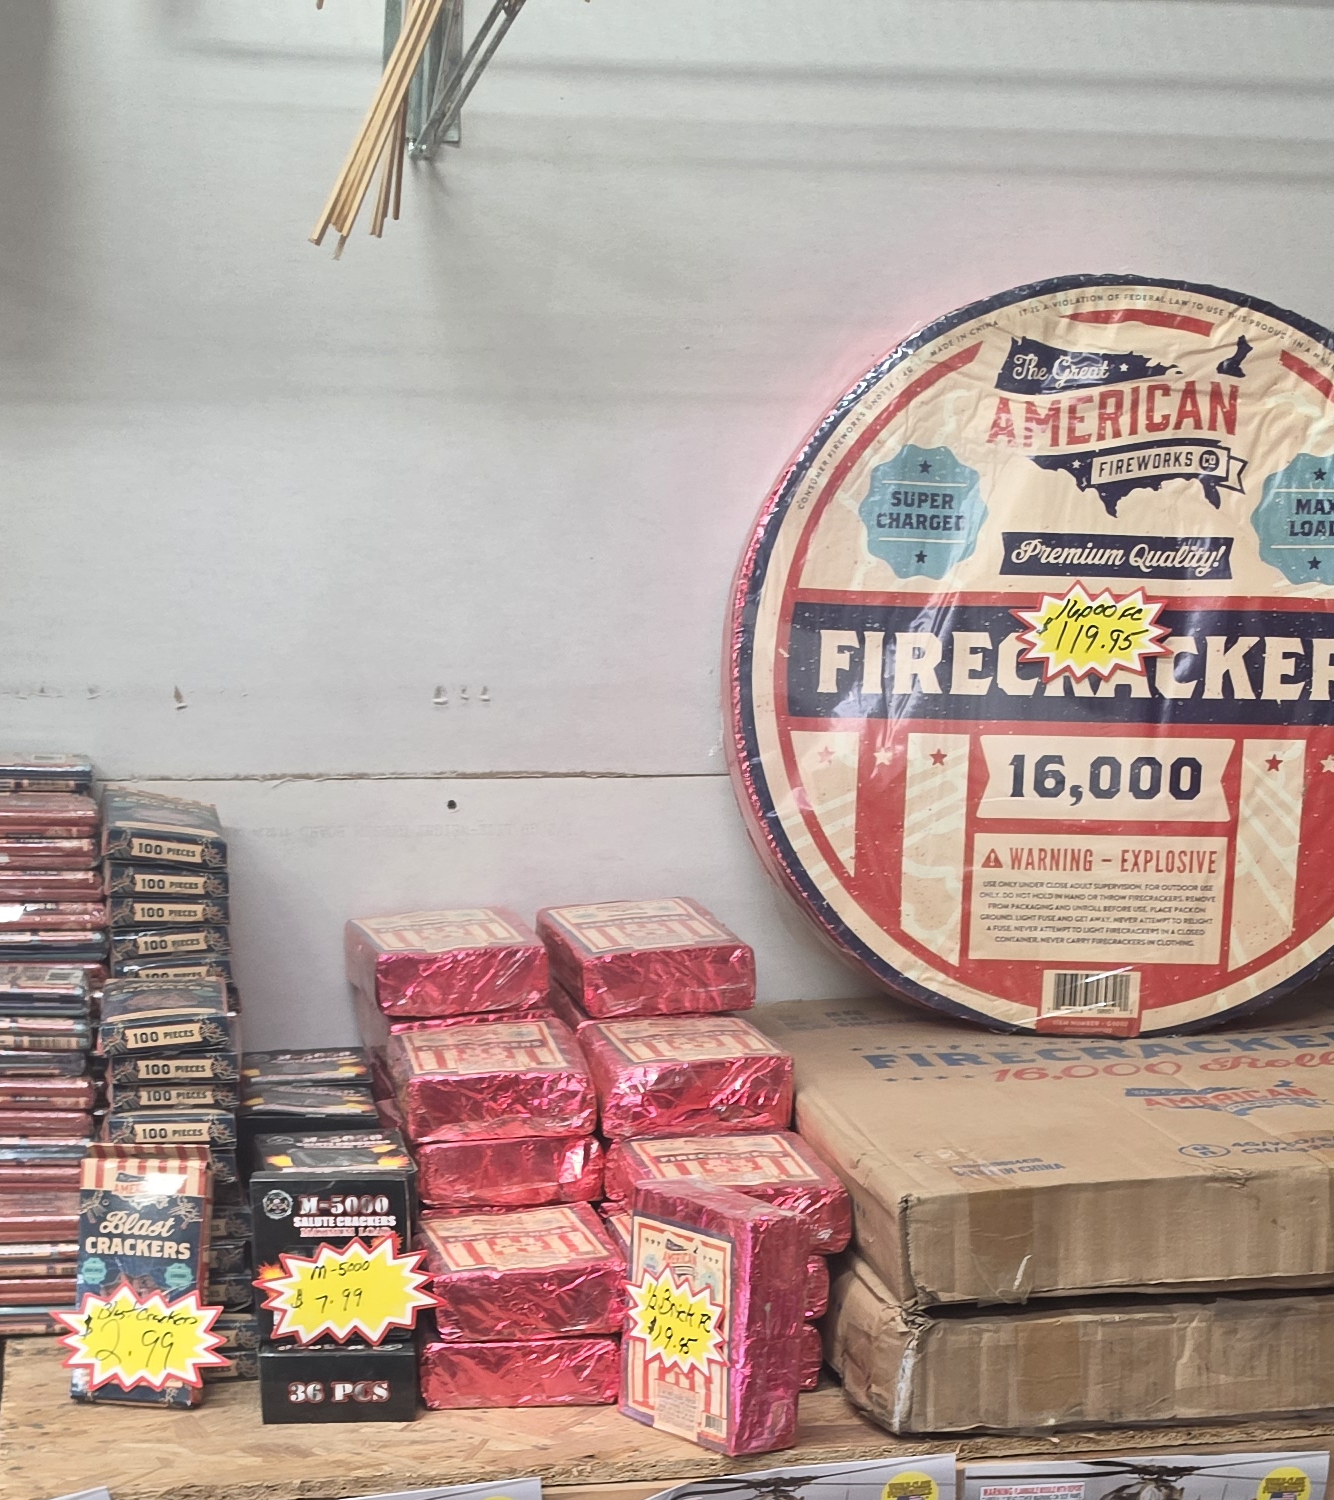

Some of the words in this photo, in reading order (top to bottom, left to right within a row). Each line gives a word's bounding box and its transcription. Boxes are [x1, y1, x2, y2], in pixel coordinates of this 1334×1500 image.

[1052, 295, 1104, 309] VIOLATION
[1013, 353, 1048, 381] The
[1051, 355, 1111, 389] Great
[986, 379, 1240, 448] AMERICAN
[1098, 451, 1194, 478] FIREWORKS
[890, 490, 955, 510] SUPER
[1011, 538, 1126, 566] Premium
[1129, 542, 1227, 576] Quality!
[1009, 754, 1203, 805] 16,000
[138, 843, 163, 855] 100
[167, 847, 196, 858] PIECES
[1009, 847, 1094, 872] WARNING
[1120, 850, 1218, 874] EXPLOSIVE
[141, 878, 165, 889] 100
[169, 881, 199, 890] PIECES
[140, 908, 165, 918] 100
[168, 908, 198, 918] PIECES
[143, 939, 167, 950] 100
[133, 1031, 159, 1044] 100
[163, 1028, 195, 1040] PIECES
[145, 1063, 170, 1075] 100
[175, 1064, 206, 1073] PIECES
[991, 1060, 1183, 1084] 16,000
[146, 1091, 171, 1102] 100
[1144, 1085, 1318, 1109] AMERICAN
[141, 1127, 168, 1139] 100
[171, 1127, 204, 1138] PIECES
[1018, 1161, 1067, 1174] CHINA
[299, 1194, 391, 1216] M-5000
[99, 1210, 175, 1238] Blast
[293, 1216, 336, 1228] SALUTE
[336, 1215, 397, 1227] CRACKERS
[85, 1236, 192, 1261] CRACKERS
[288, 1382, 324, 1403] 36
[331, 1380, 391, 1403] PCS
